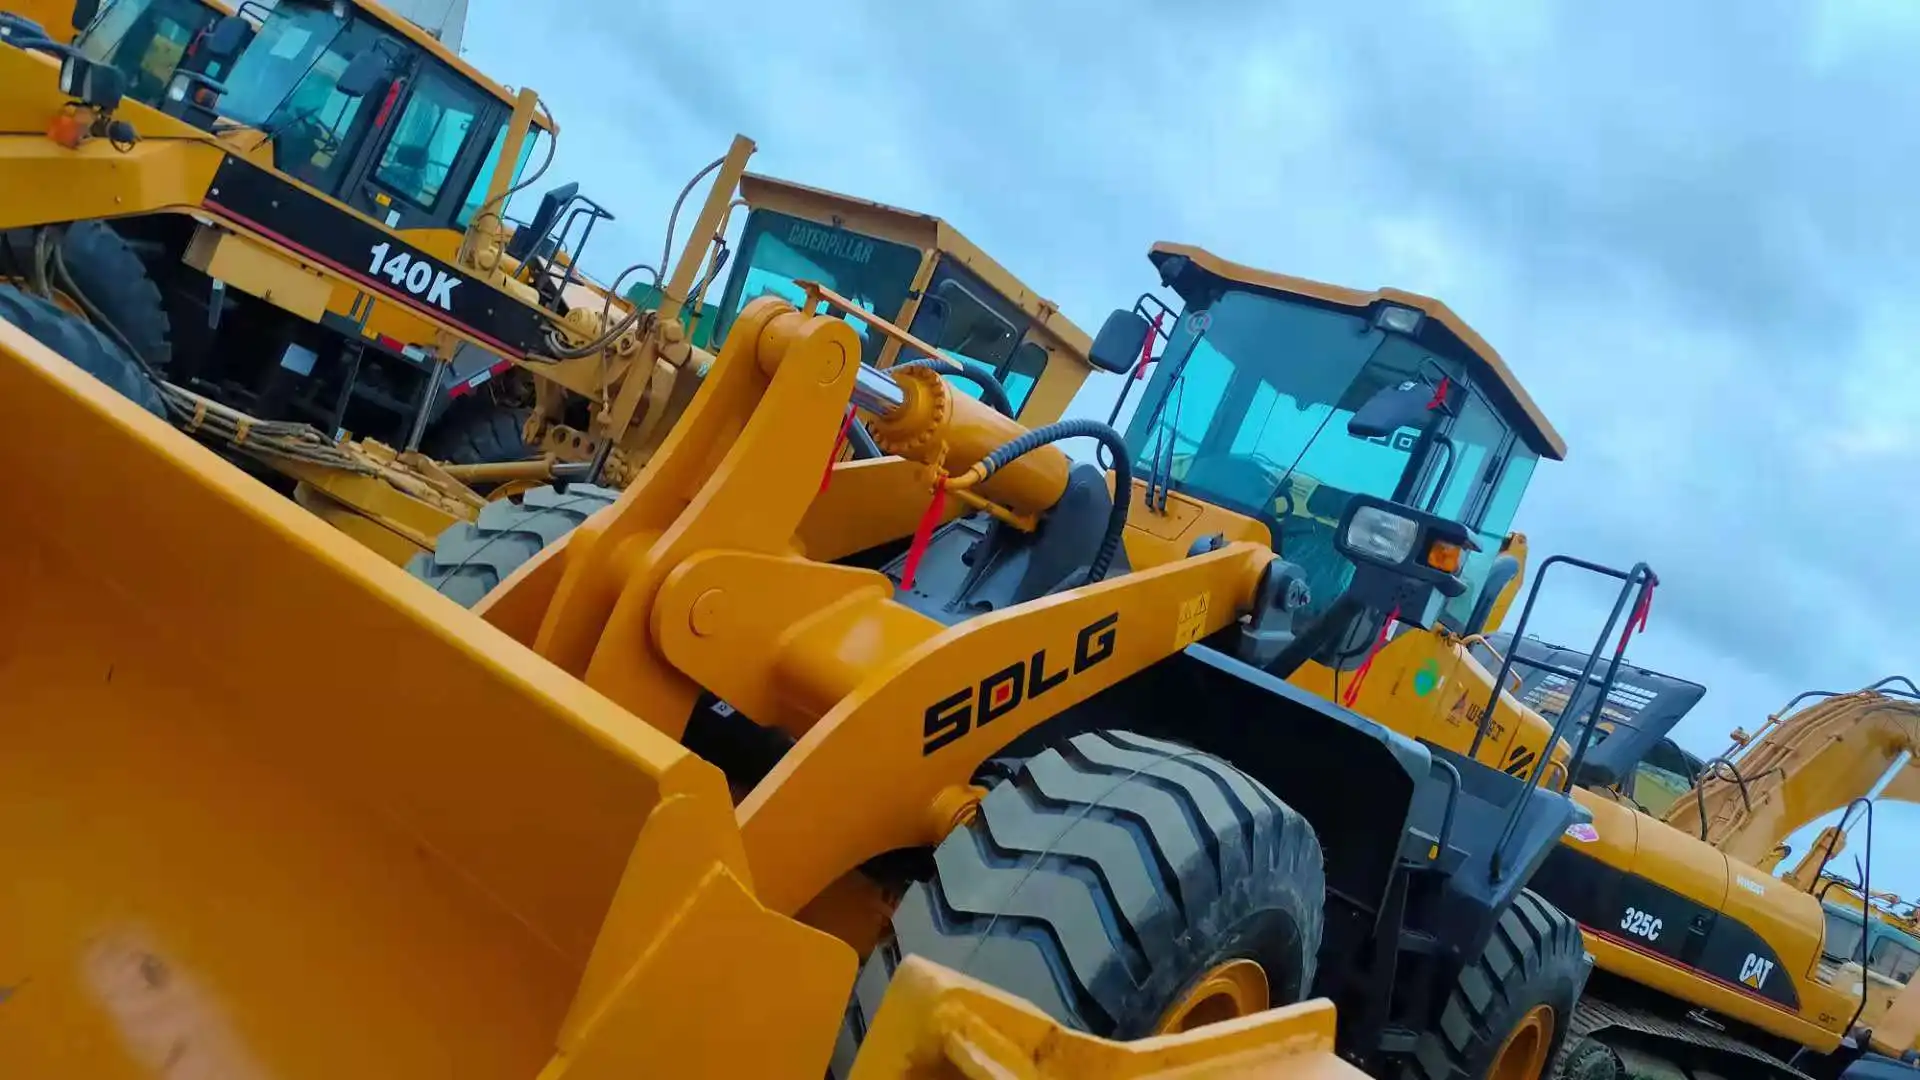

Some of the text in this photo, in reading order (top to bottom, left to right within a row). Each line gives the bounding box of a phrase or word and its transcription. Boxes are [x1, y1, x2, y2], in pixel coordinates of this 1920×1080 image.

[788, 223, 874, 264] CATERPILLAR
[368, 242, 462, 311] 140K
[923, 612, 1119, 757] SDLG
[1620, 906, 1663, 941] 325C
[1738, 952, 1775, 990] CAT
